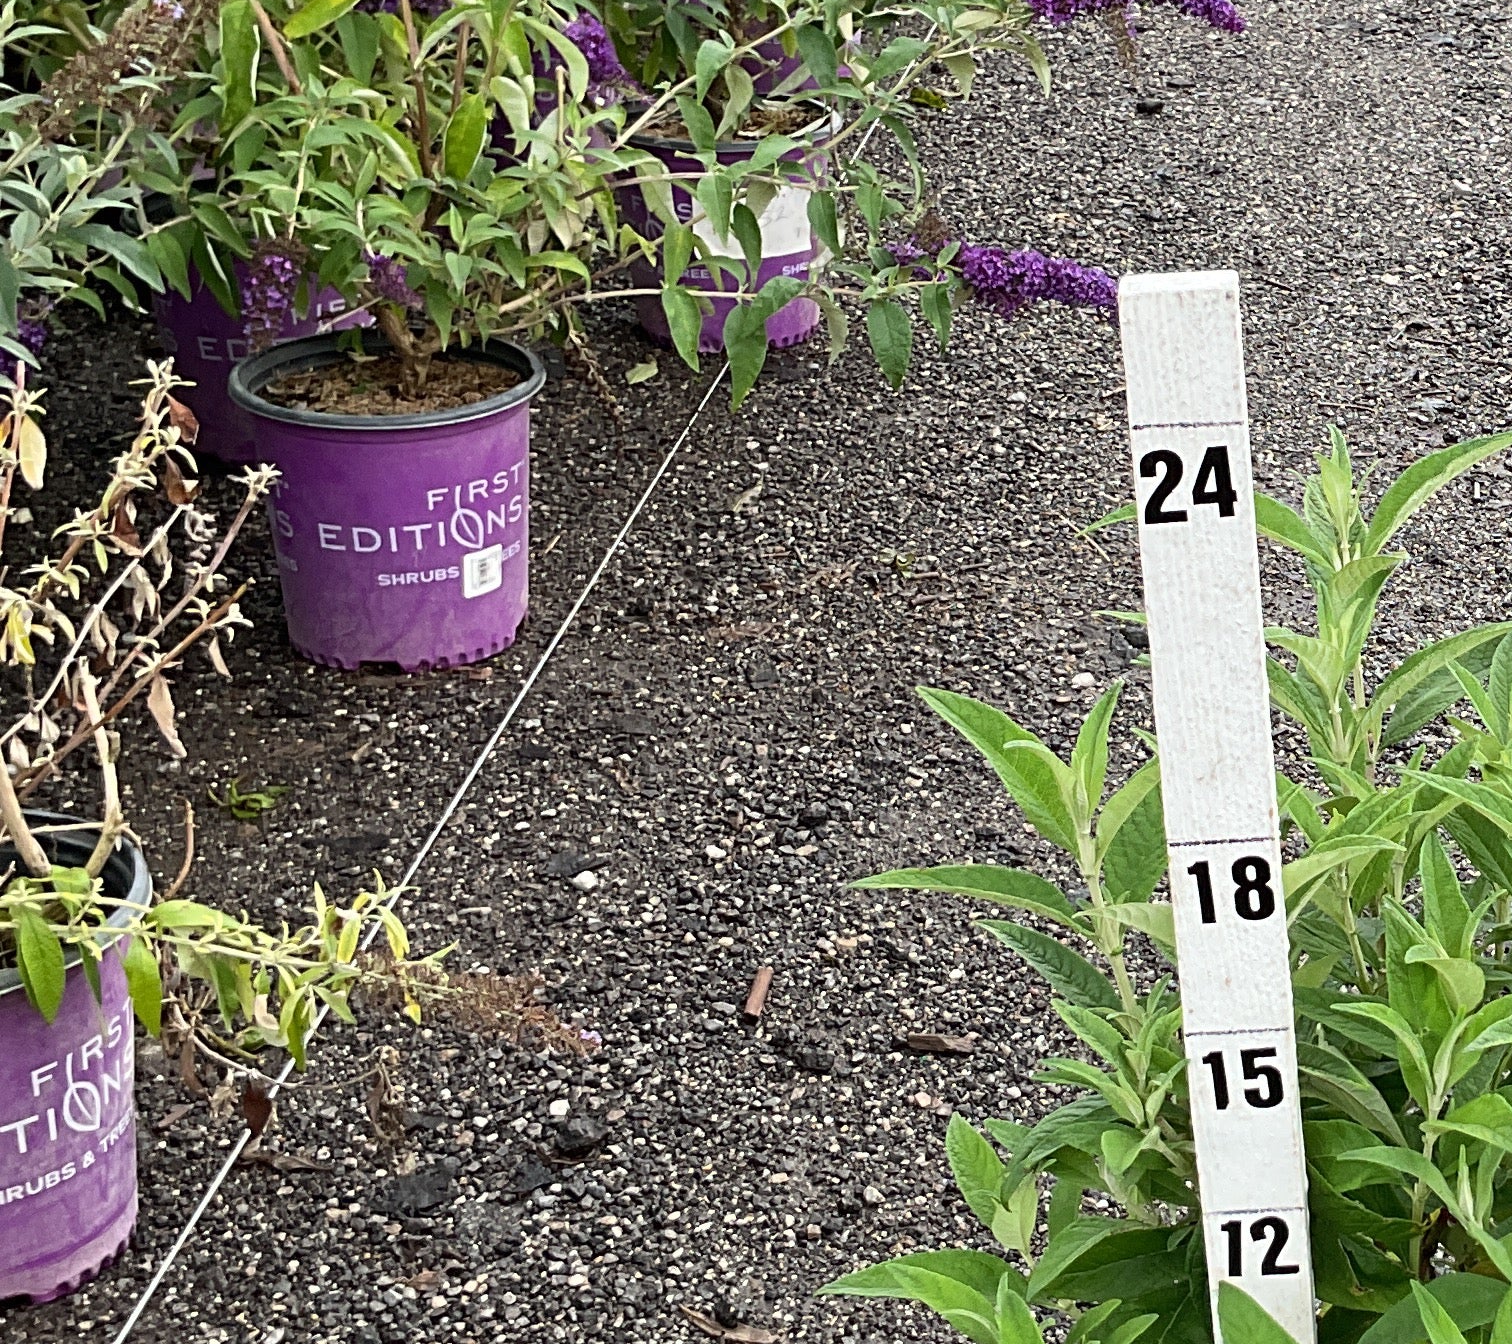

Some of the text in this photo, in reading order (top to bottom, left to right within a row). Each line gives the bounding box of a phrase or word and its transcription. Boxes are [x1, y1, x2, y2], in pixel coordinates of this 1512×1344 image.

[426, 461, 525, 511] FIRST
[1138, 445, 1238, 525] 24
[317, 494, 522, 553] EDITIONS
[377, 566, 461, 587] SHRUBS
[1187, 855, 1276, 924] 18
[1202, 1047, 1284, 1110] 15
[1220, 1216, 1300, 1277] 12
